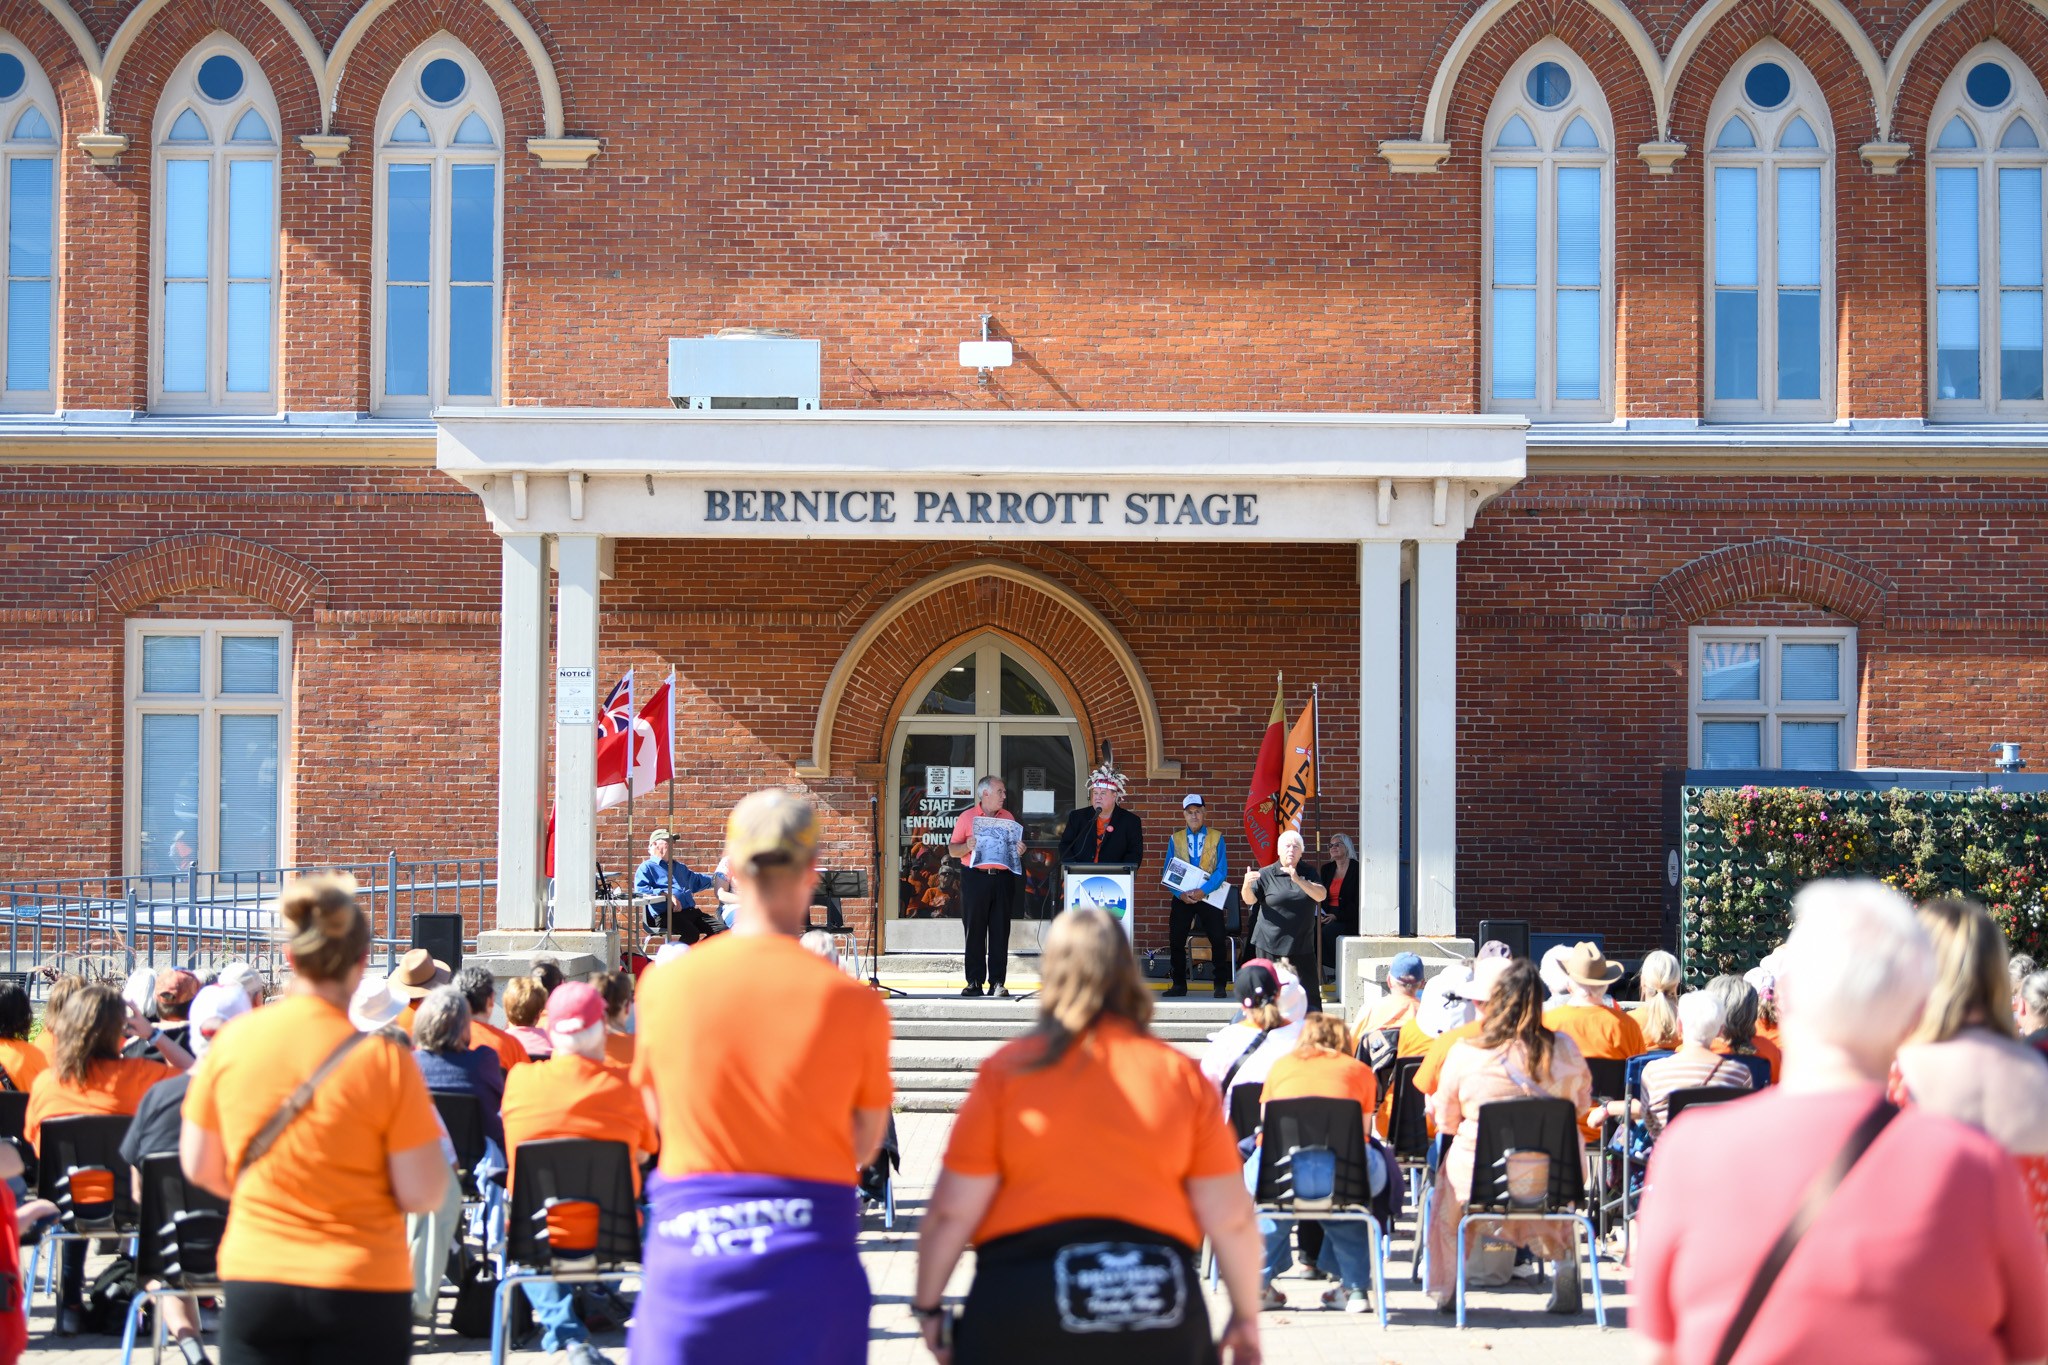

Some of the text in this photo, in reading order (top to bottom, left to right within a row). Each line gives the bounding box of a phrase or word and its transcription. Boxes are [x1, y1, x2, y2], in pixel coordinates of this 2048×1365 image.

[704, 489, 1260, 527] BERNICE PARROTT STAGE
[919, 799, 955, 811] STAFF
[906, 815, 959, 828] ENTRAN
[1246, 808, 1270, 850] leville
[922, 833, 952, 845] ONLY
